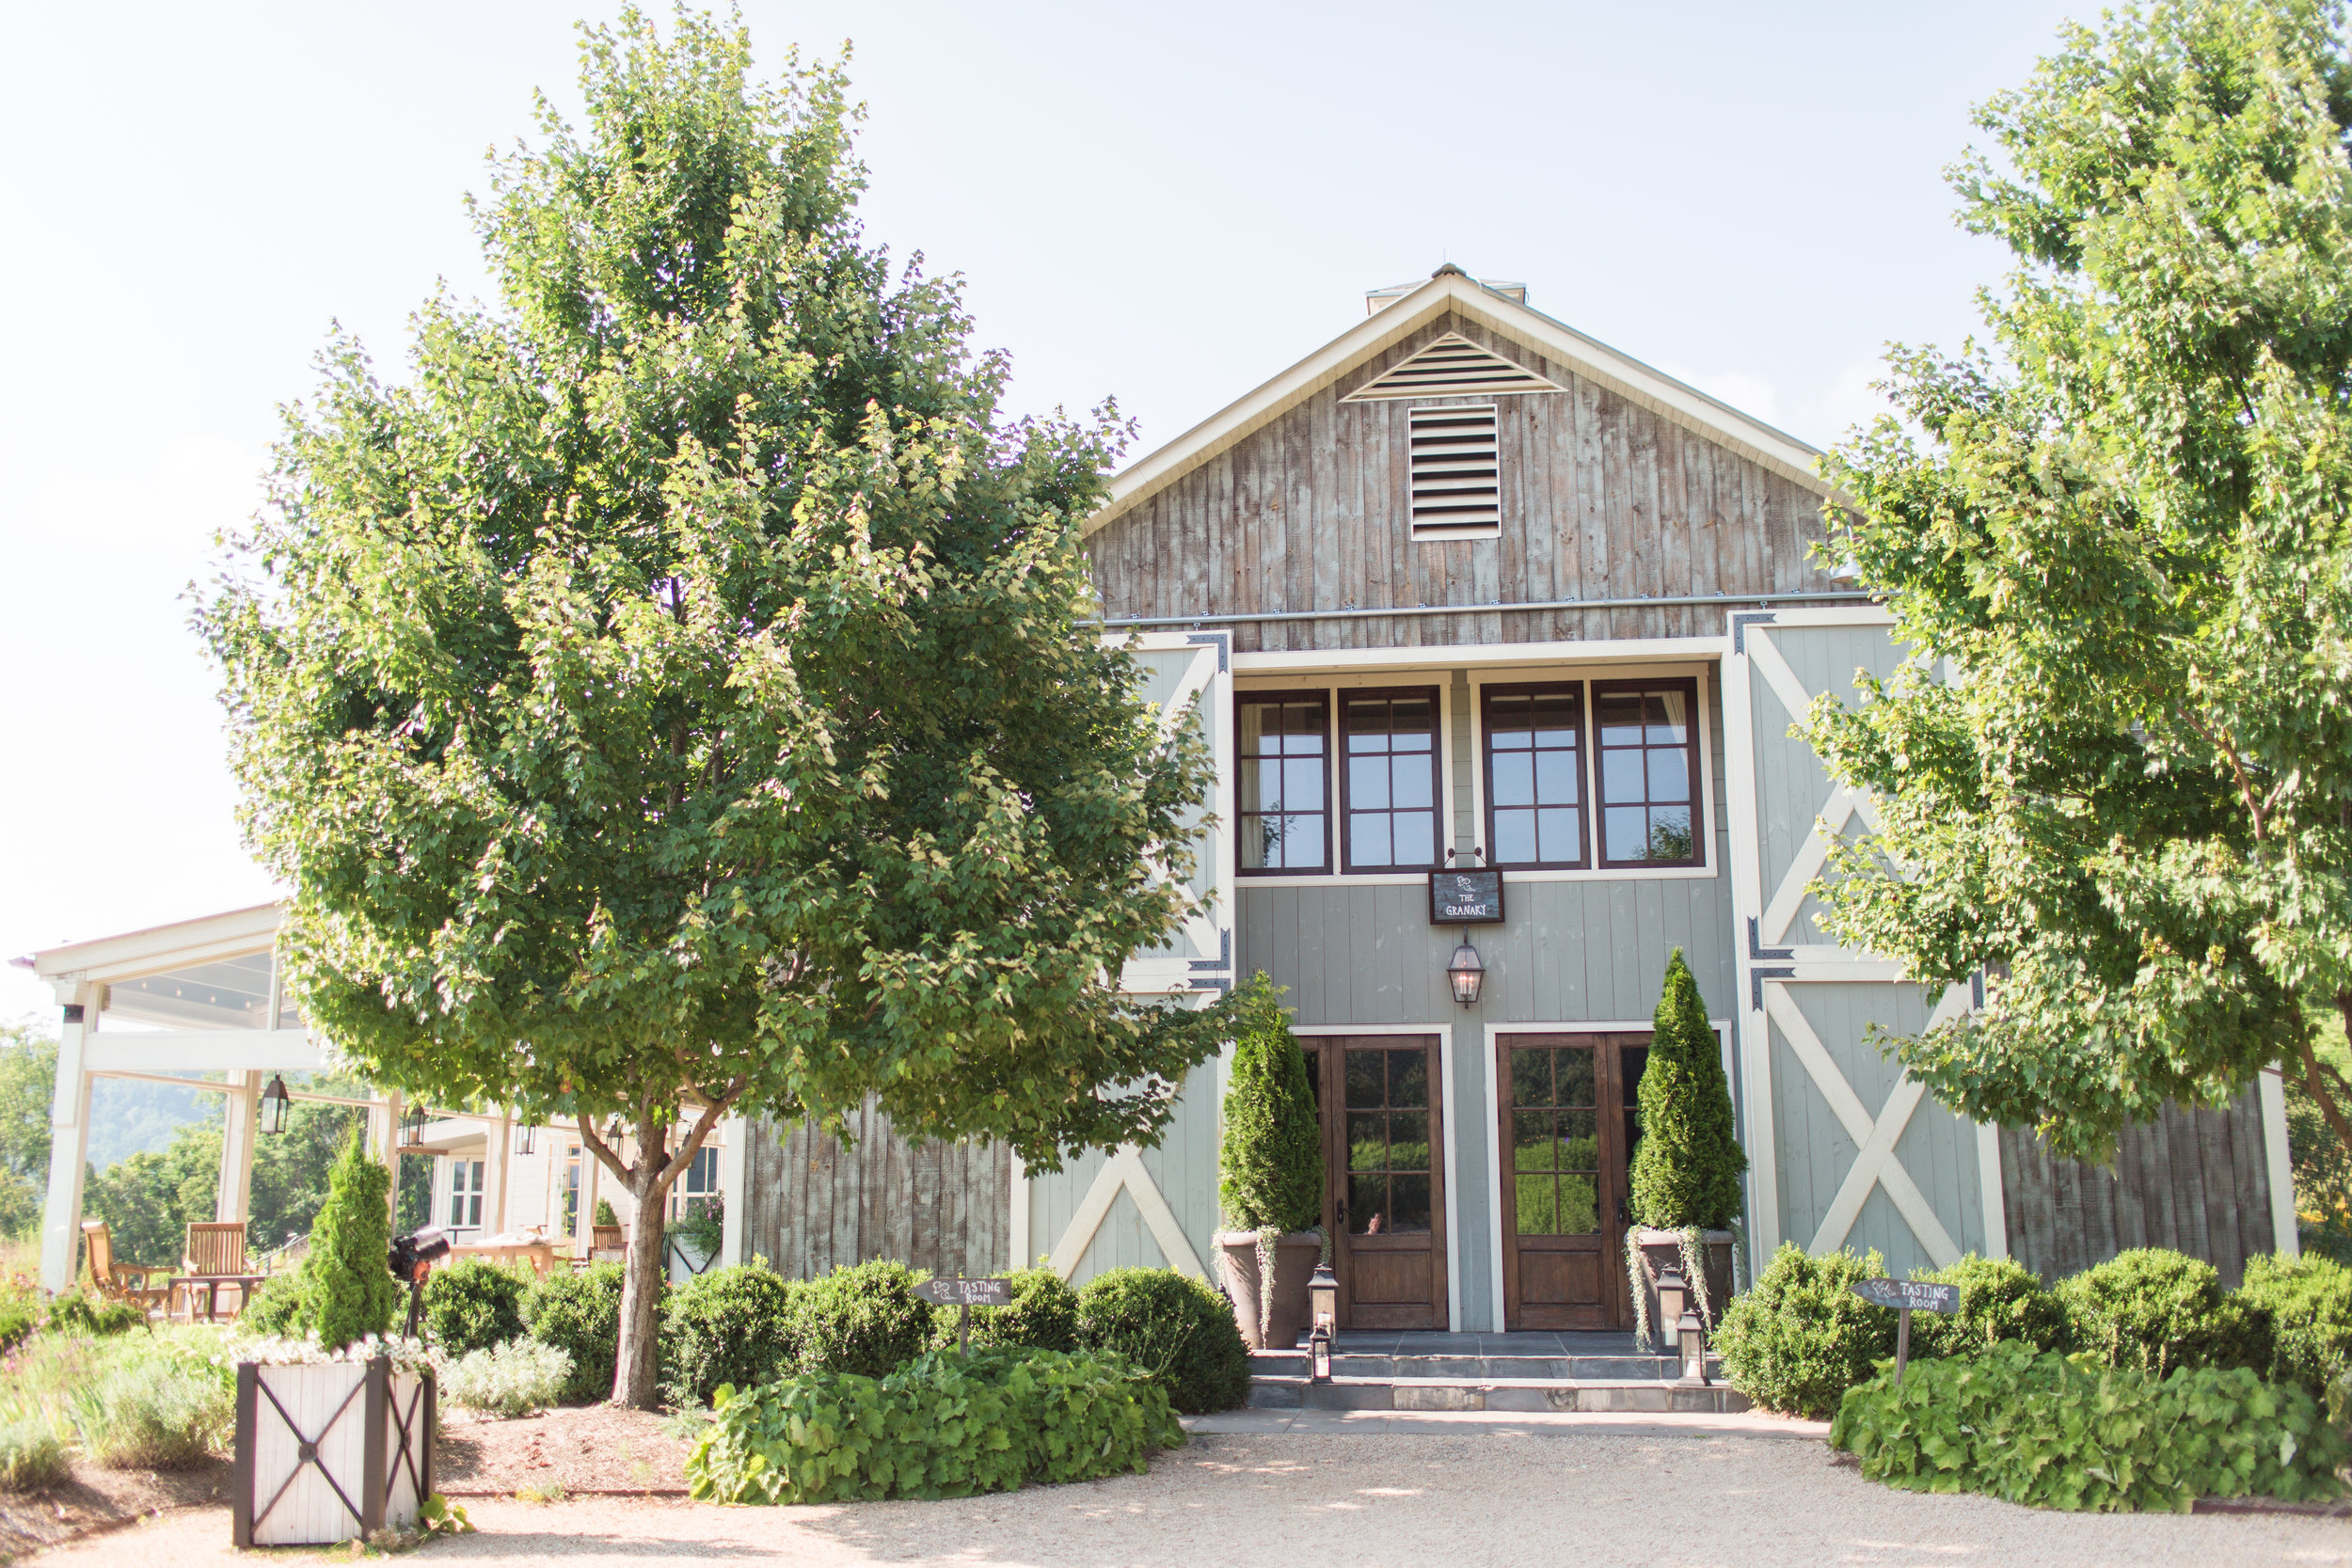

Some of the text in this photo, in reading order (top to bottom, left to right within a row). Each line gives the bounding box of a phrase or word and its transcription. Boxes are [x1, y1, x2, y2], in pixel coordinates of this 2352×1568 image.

[1458, 894, 1474, 902] THE
[1446, 904, 1486, 916] GRANARY
[958, 1280, 1001, 1294] TASTING
[1909, 1296, 1938, 1310] ROOM
